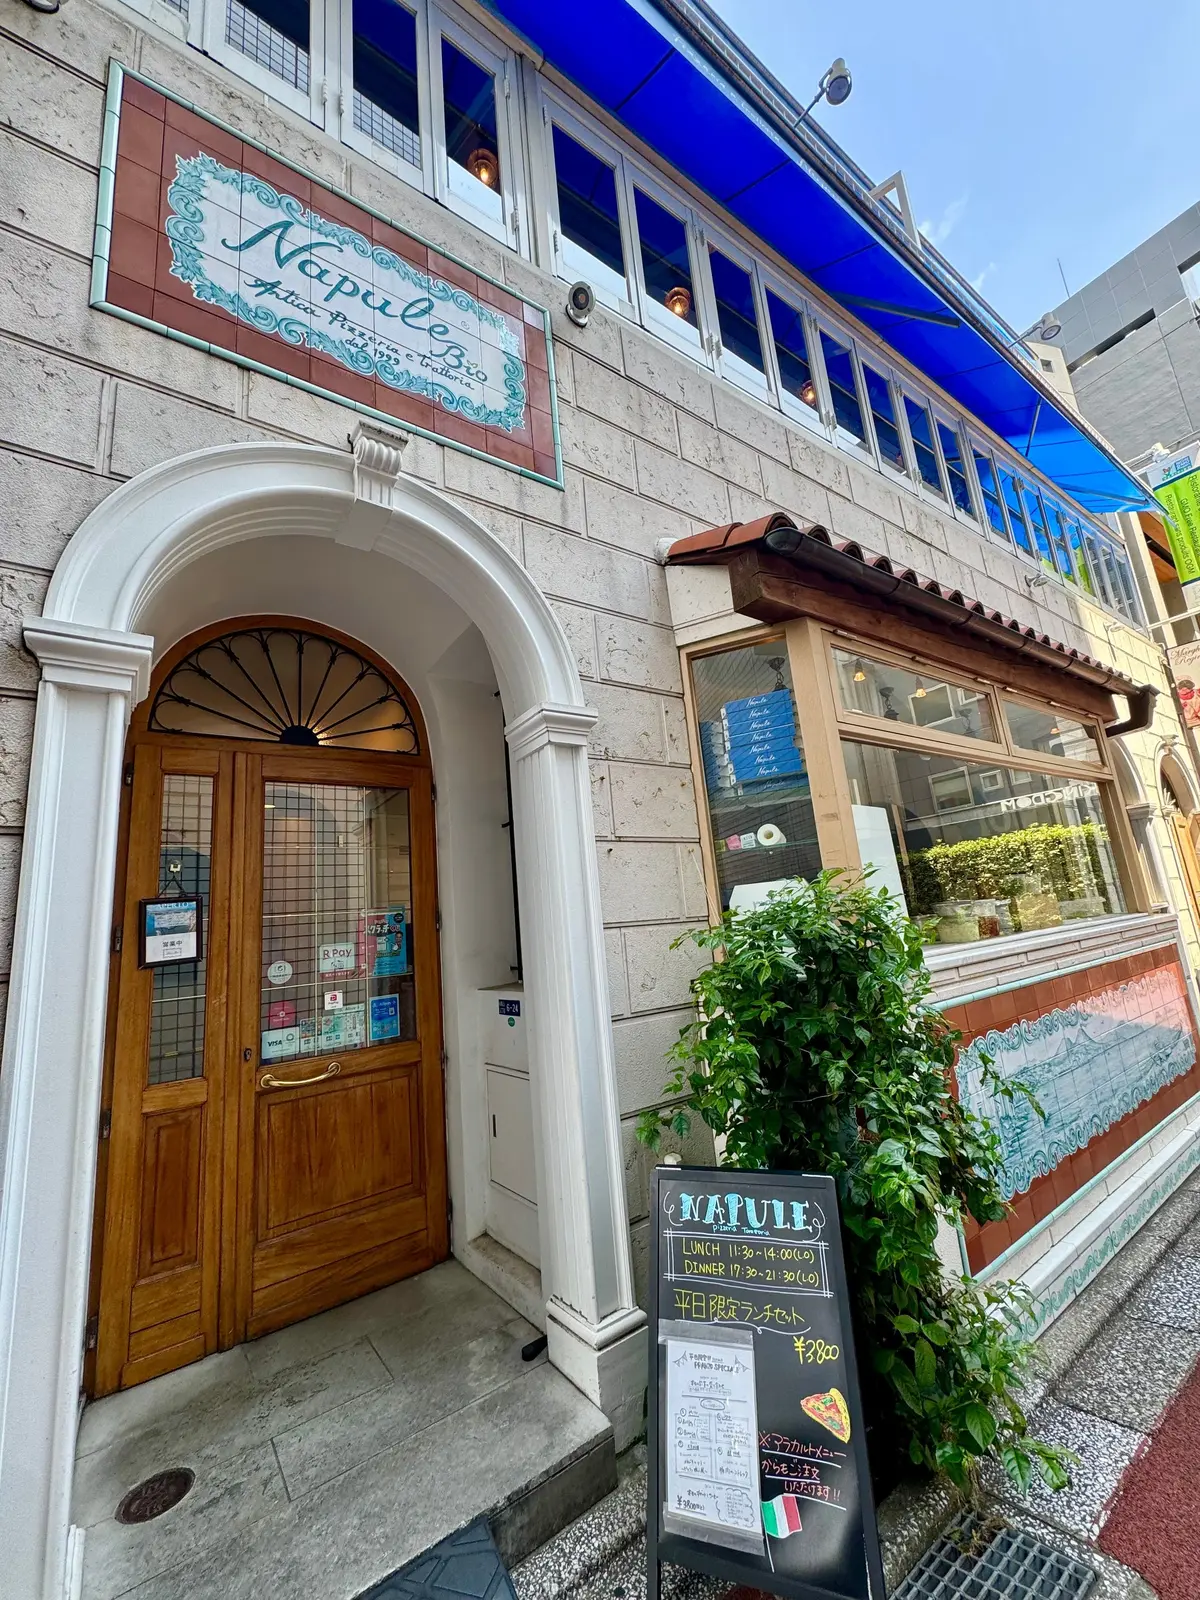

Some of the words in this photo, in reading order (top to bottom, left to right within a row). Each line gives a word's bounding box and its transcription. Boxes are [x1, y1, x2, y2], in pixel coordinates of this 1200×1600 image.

[221, 220, 468, 351] Napule
[243, 278, 321, 318] Antica
[329, 310, 401, 357] Pizzeria
[405, 353, 415, 362] e
[345, 338, 369, 352] dal
[373, 348, 400, 366] 1999
[429, 344, 488, 383] Bio
[332, 948, 352, 958] Pay
[267, 1039, 283, 1048] VISA
[679, 1193, 812, 1233] NAPULE
[682, 1237, 721, 1256] LUNCH
[684, 1260, 725, 1275] DINNER
[673, 1288, 805, 1325] 平日限定ランチセット
[793, 1336, 840, 1365] ¥3800
[761, 1458, 820, 1480] からもご注文
